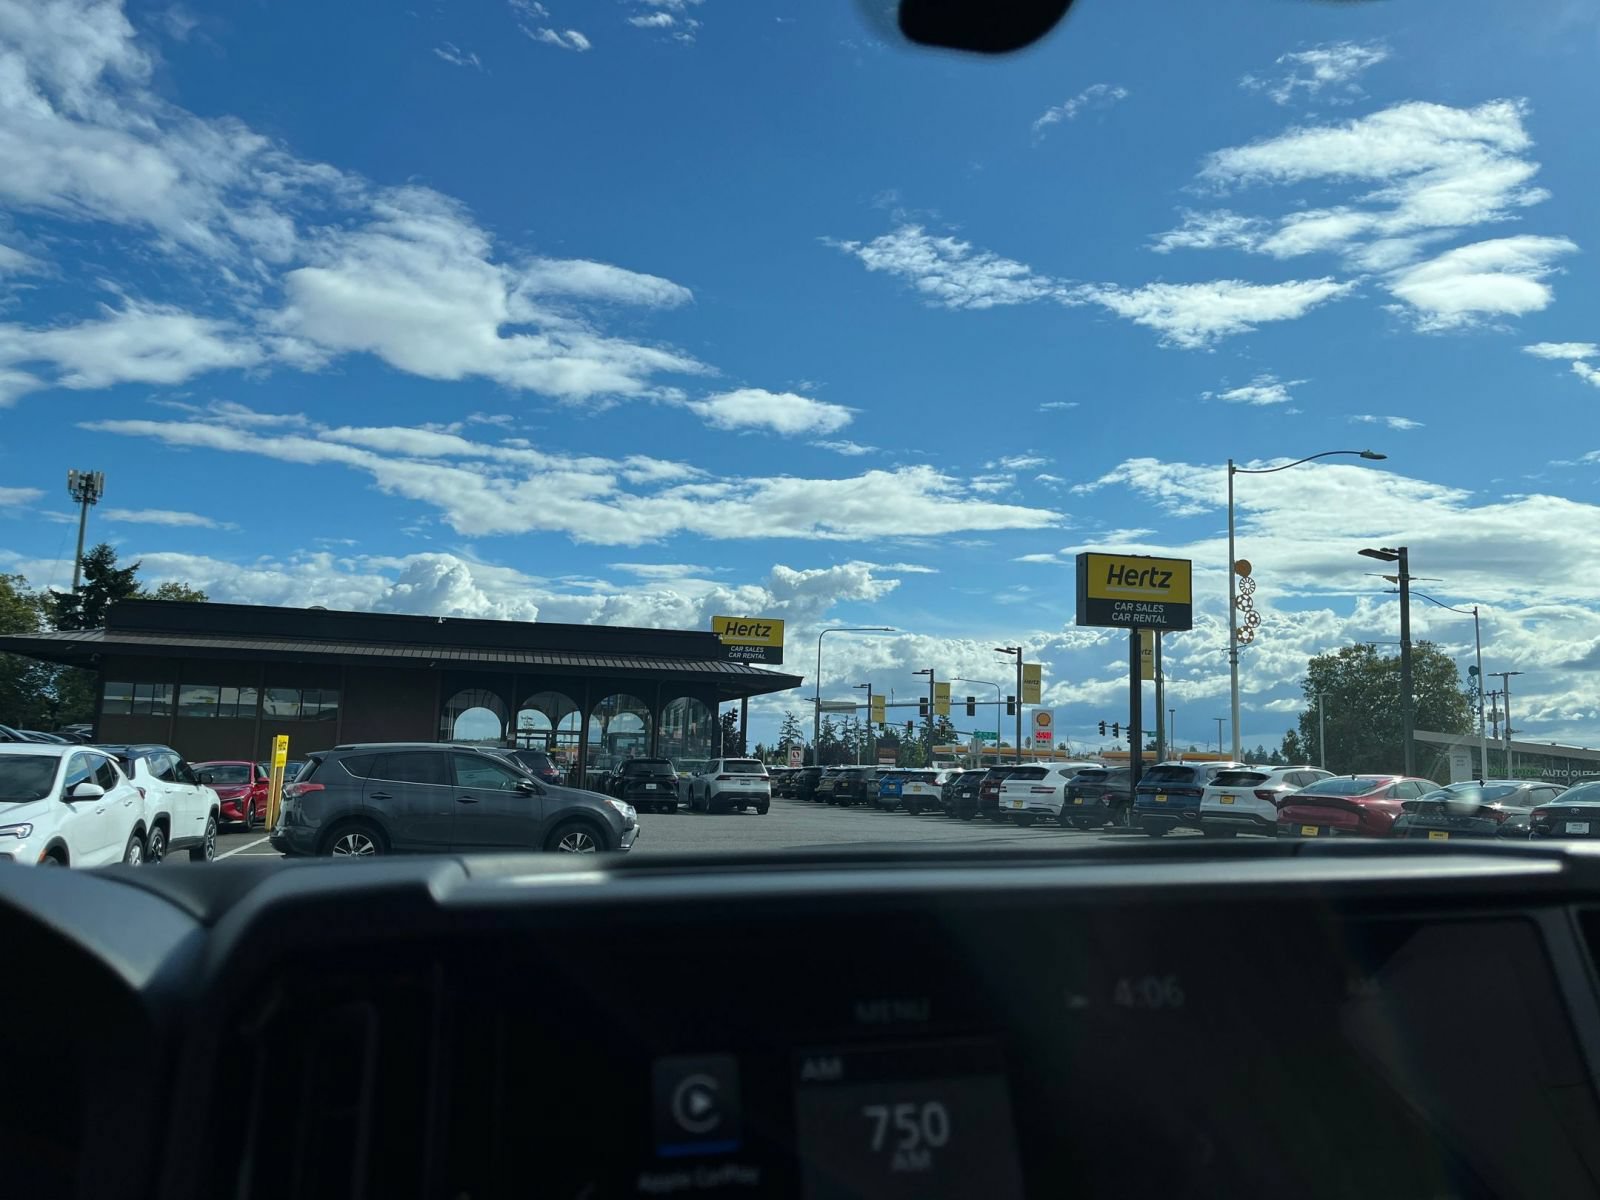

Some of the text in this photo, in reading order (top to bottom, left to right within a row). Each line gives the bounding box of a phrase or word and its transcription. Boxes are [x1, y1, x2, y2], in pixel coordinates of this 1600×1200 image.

[1107, 563, 1173, 588] Hertz
[1114, 602, 1164, 613] CAR SALES
[1112, 612, 1168, 624] CAR RENTAL
[725, 621, 772, 637] Hertz
[1541, 769, 1569, 777] AUTO
[801, 1057, 843, 1080] AM
[863, 1102, 949, 1151] 750
[892, 1150, 932, 1172] AM
